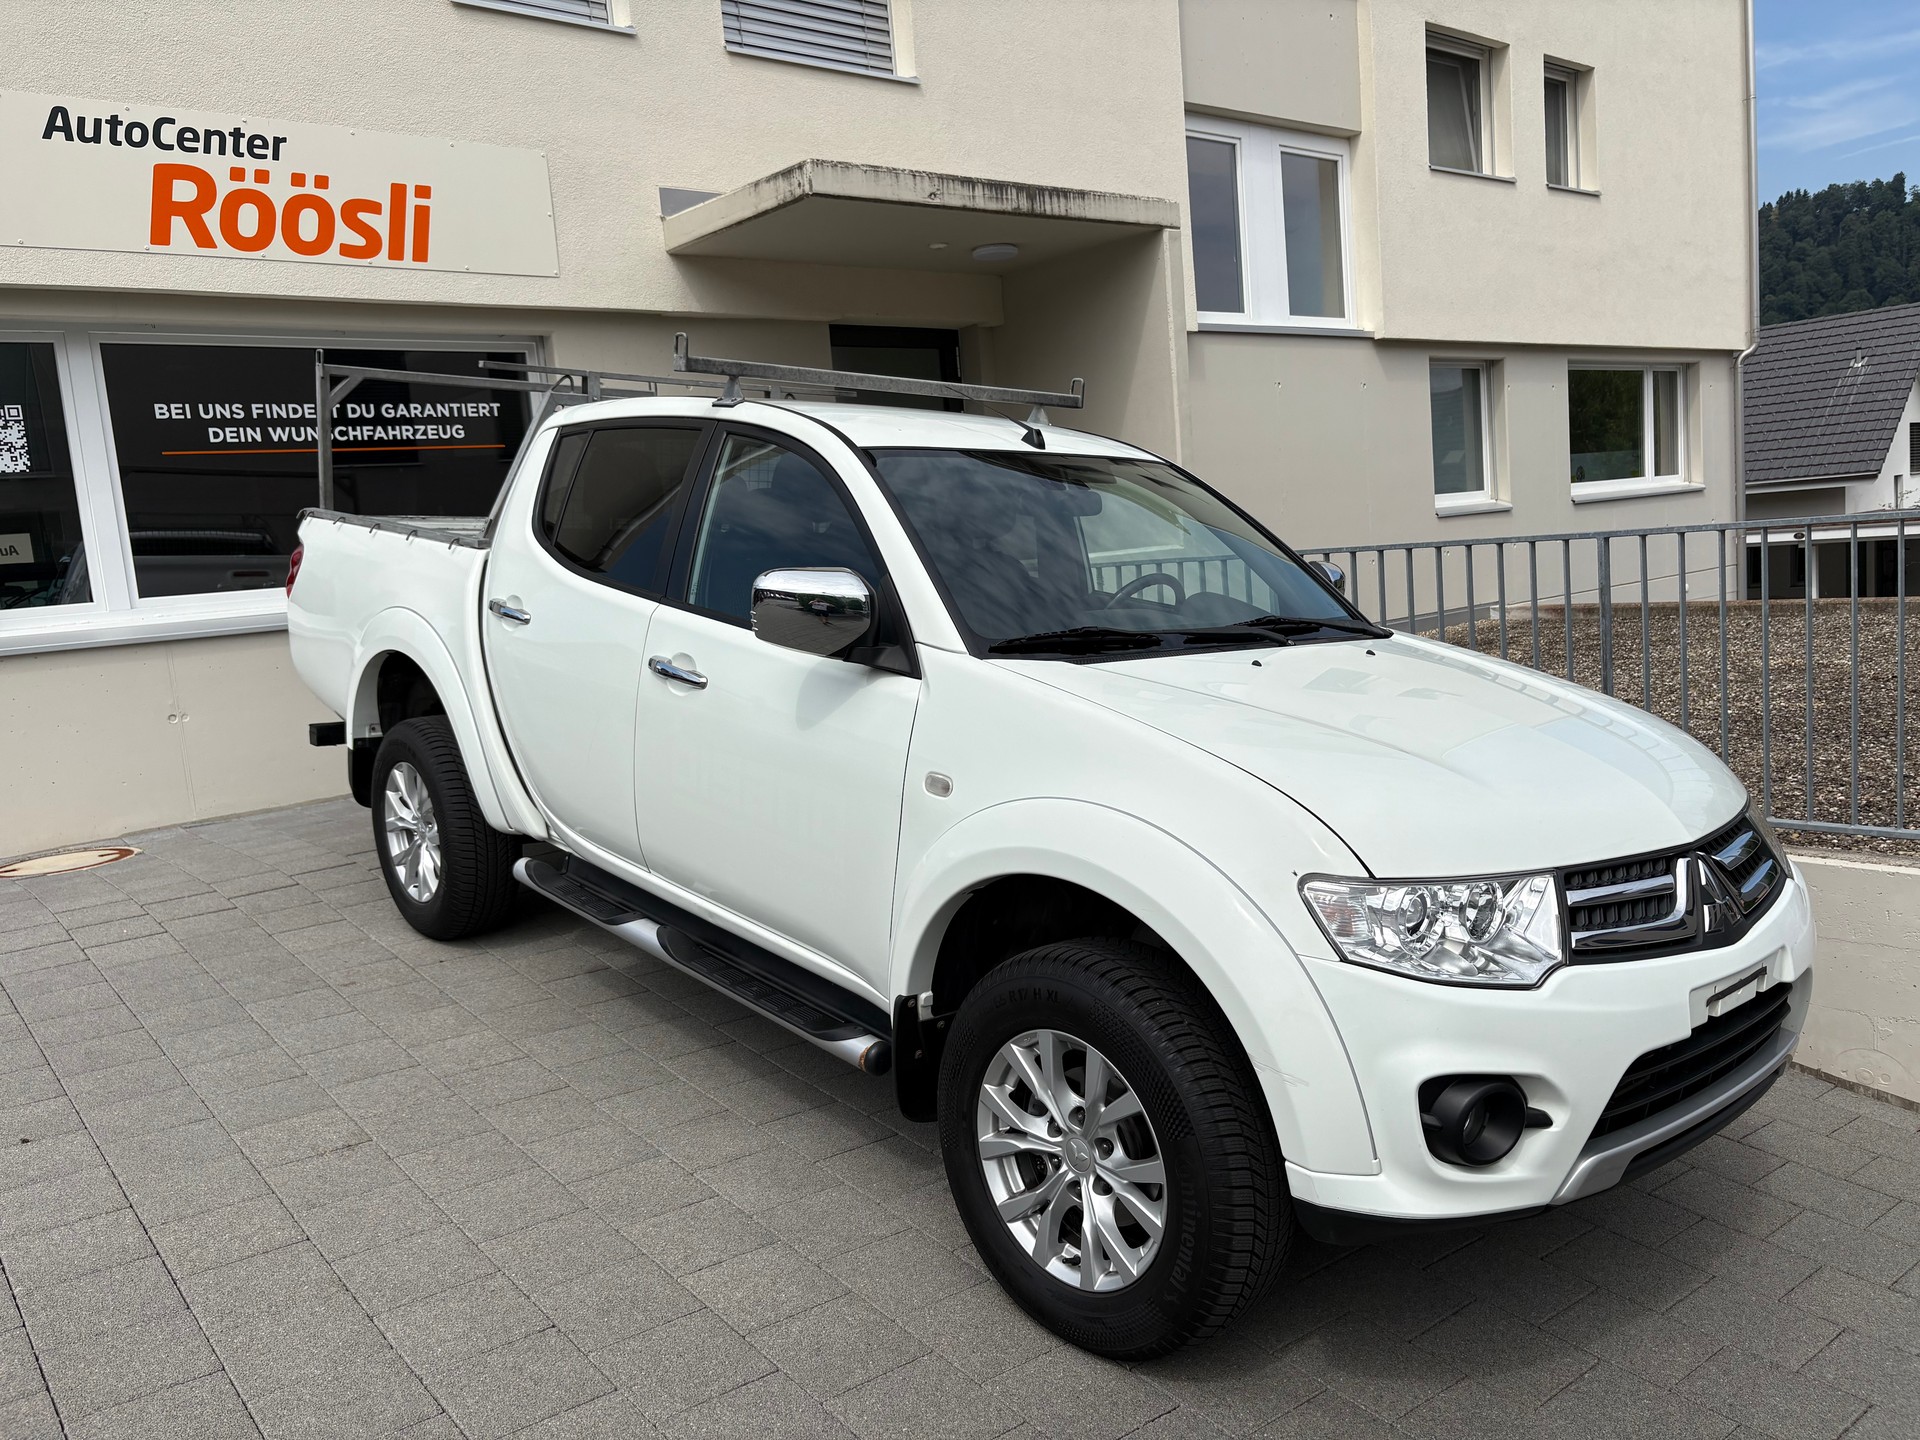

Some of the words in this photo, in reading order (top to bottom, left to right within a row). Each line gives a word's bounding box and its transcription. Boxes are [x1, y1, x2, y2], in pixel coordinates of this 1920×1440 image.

[41, 105, 288, 162] AutoCenter
[149, 162, 432, 263] Röösli
[153, 403, 192, 419] BEI
[198, 403, 245, 420] UNS
[251, 403, 341, 419] FINDET
[347, 403, 375, 419] DU
[381, 402, 501, 419] GARANTIERT
[208, 426, 262, 443] DEIN
